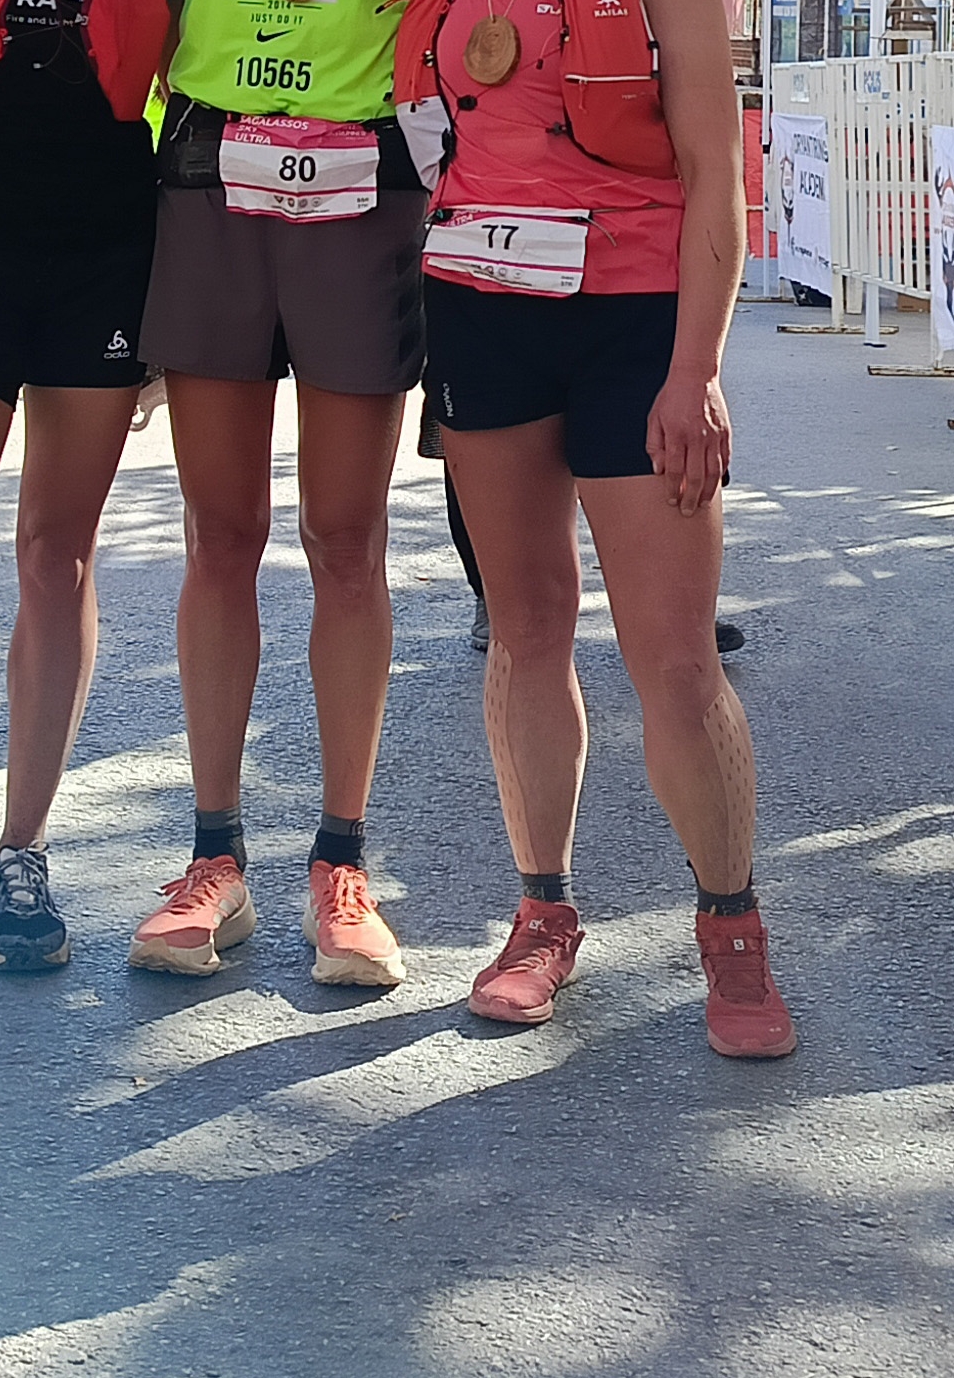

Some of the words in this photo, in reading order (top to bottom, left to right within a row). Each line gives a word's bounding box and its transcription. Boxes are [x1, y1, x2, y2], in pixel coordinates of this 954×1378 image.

[267, 0, 291, 10] 2014
[27, 16, 46, 25] and
[250, 13, 273, 23] JUST
[277, 14, 290, 24] DO
[293, 16, 304, 25] IT
[236, 56, 312, 92] 10565
[240, 115, 309, 131] SAGALASSOS
[234, 132, 271, 145] ULTRA
[279, 155, 316, 183] 80
[481, 224, 520, 250] 77
